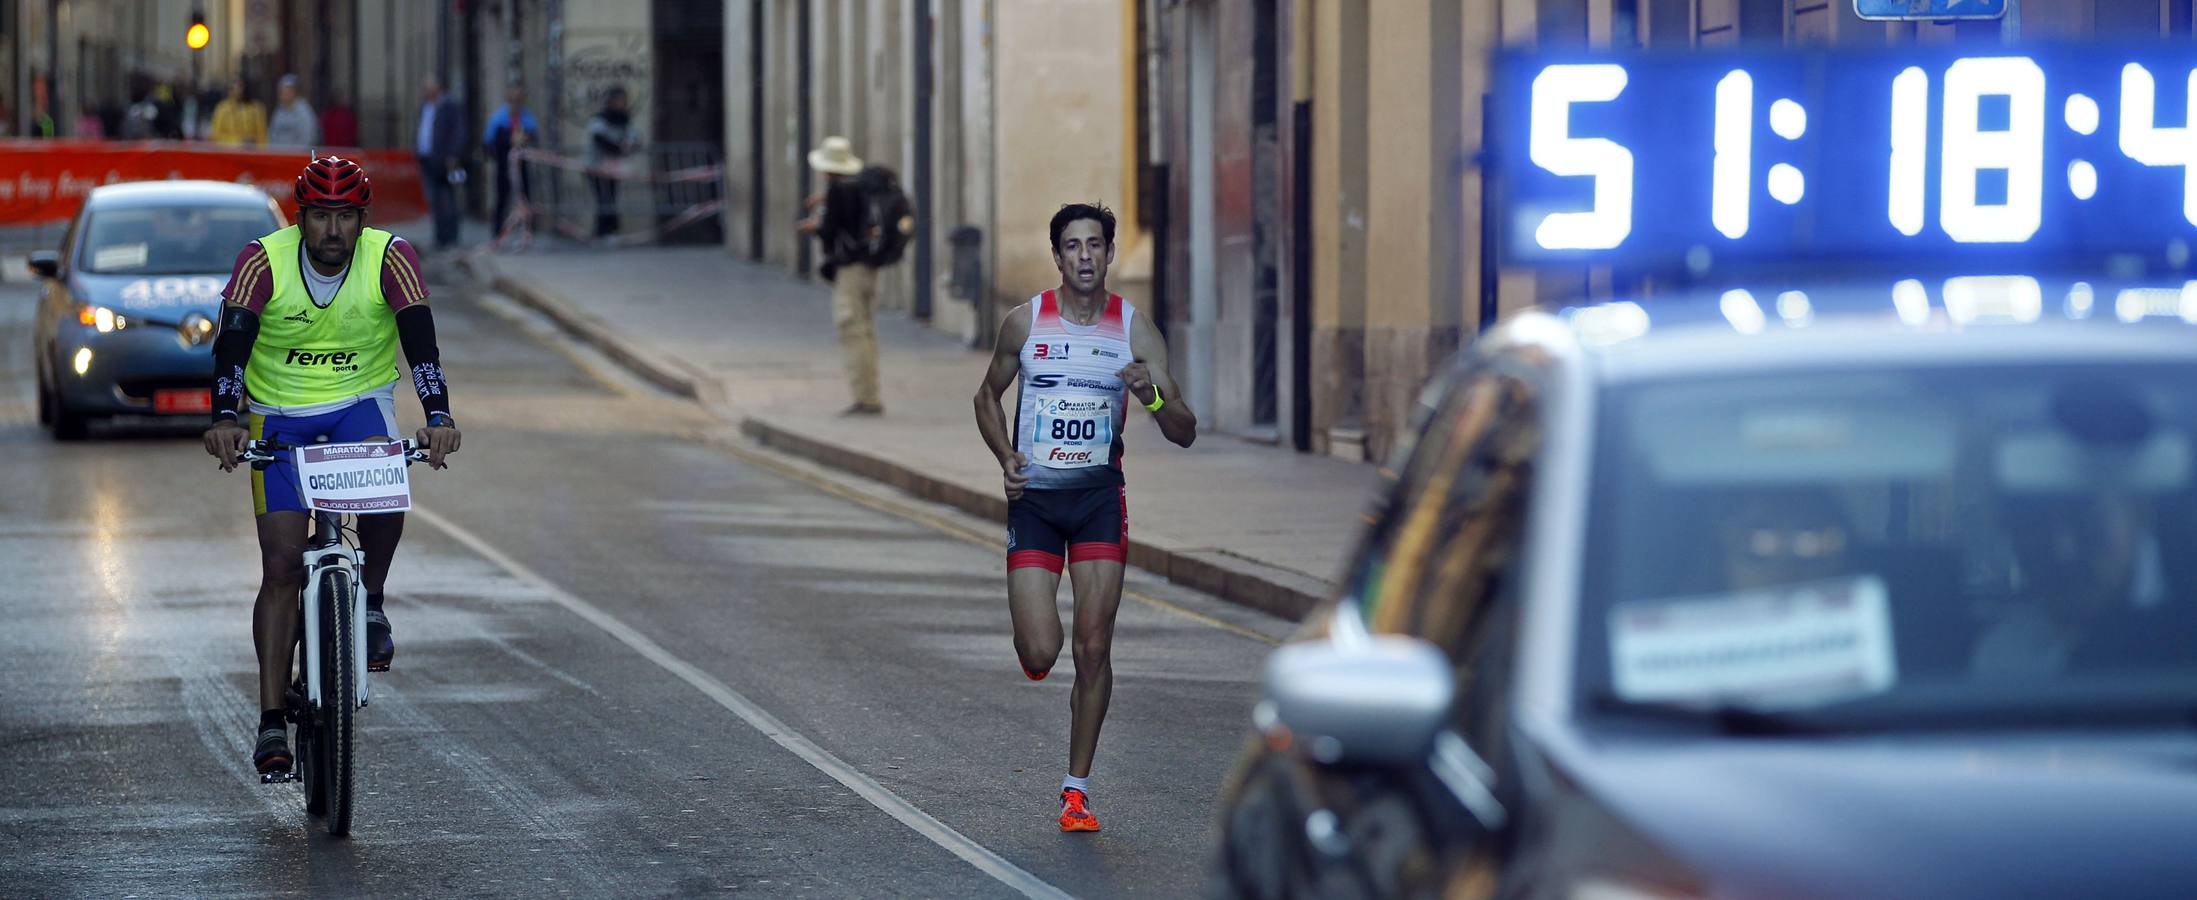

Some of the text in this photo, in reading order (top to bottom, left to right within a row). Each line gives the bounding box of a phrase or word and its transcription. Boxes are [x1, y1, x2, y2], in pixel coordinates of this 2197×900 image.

[285, 348, 358, 366] Ferrer
[332, 365, 352, 373] sport
[422, 362, 437, 380] RACE
[1051, 418, 1096, 441] 800
[1048, 446, 1092, 461] Ferrer
[308, 463, 405, 491] ORGANIZACIÓN
[319, 498, 399, 510] CIUDAD DE LOGROÑO
